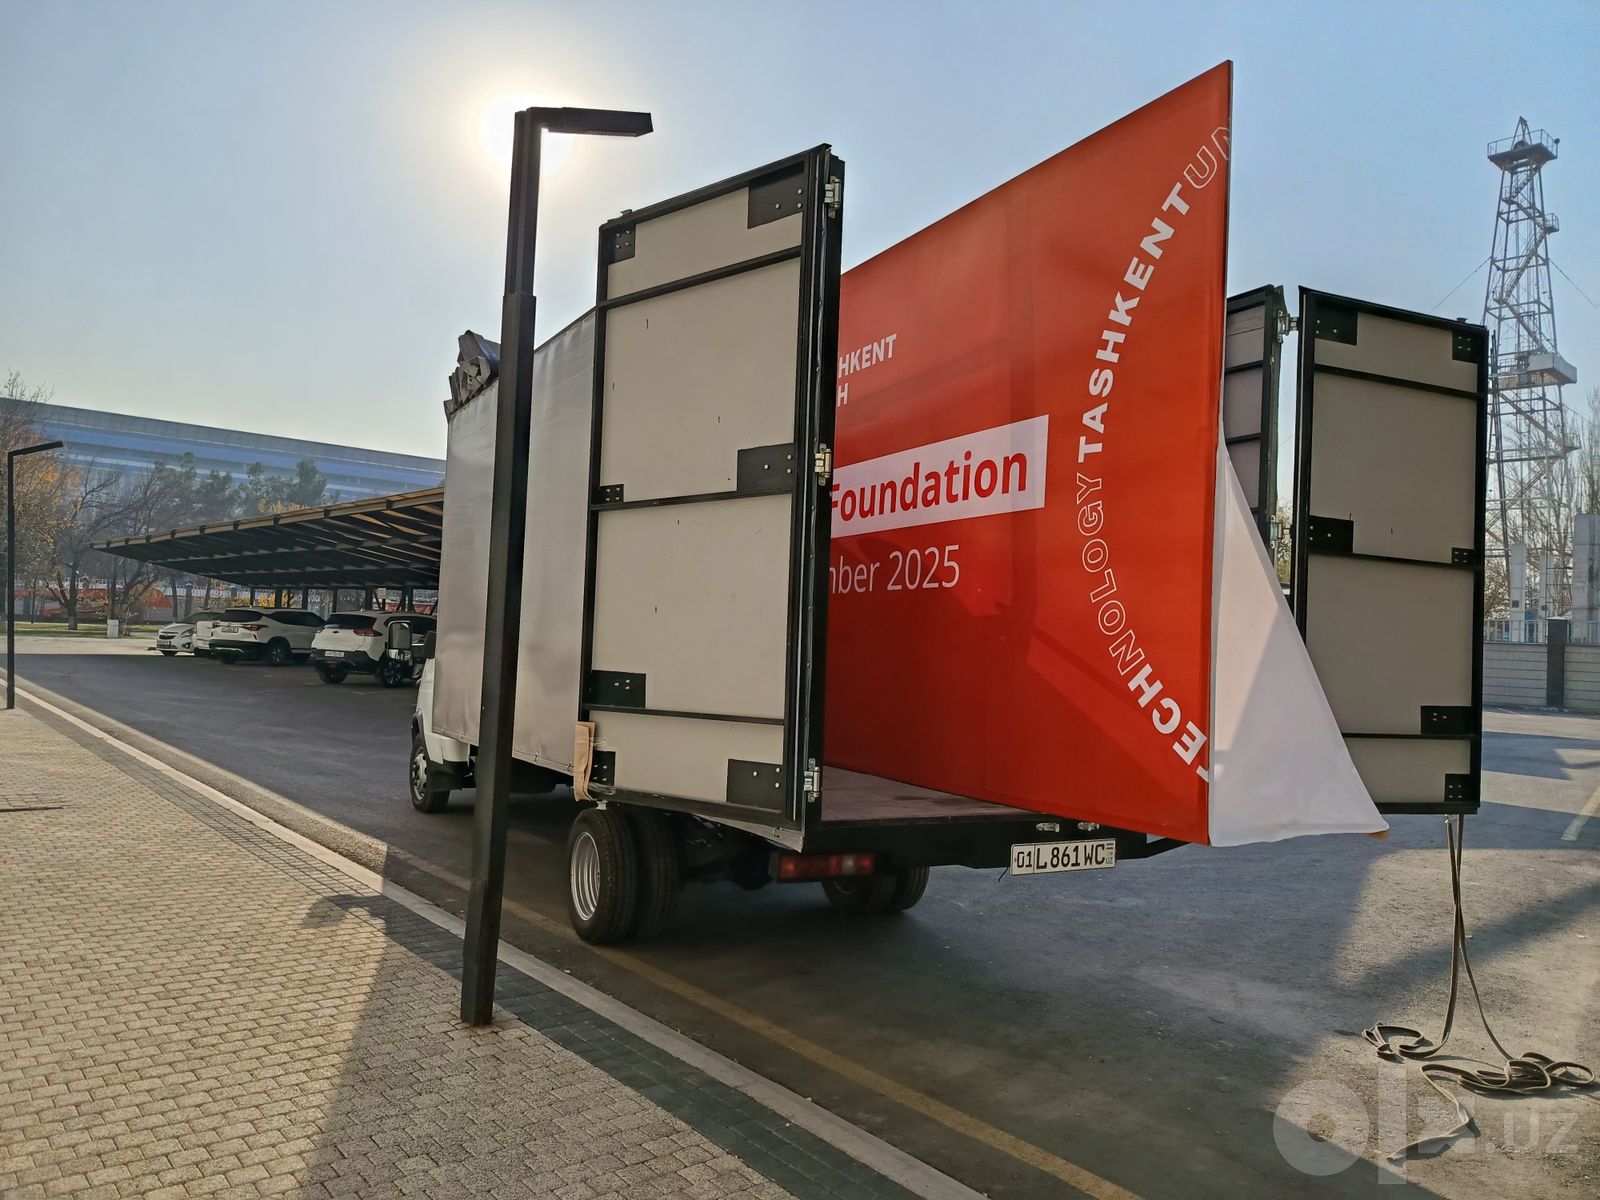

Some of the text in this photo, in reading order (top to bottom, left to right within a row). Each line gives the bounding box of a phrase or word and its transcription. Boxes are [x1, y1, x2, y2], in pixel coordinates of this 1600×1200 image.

[838, 333, 897, 379] HKENT
[837, 382, 849, 408] H
[829, 544, 960, 594] ber 2025
